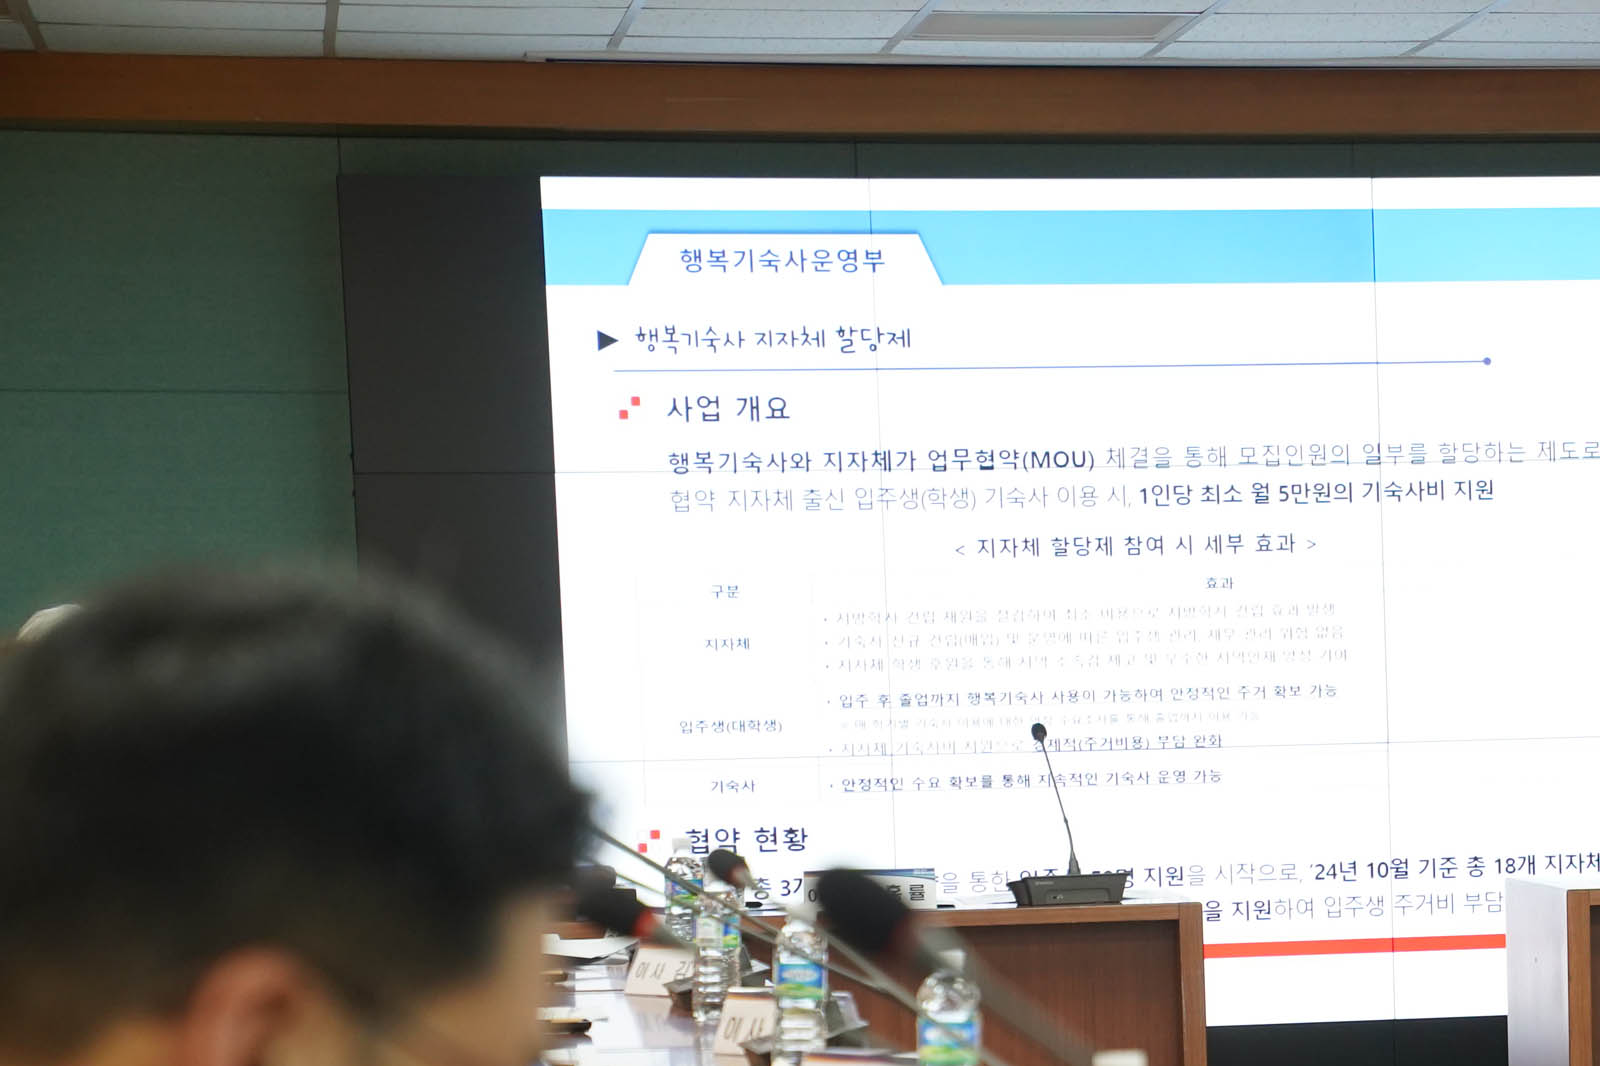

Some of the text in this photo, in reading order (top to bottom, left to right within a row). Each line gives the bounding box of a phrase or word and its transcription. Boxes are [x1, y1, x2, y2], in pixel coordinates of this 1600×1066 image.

[680, 249, 886, 273] 행복기숙사운영부
[635, 326, 912, 354] 행복기숙사 지자체 할당제
[667, 396, 790, 423] 사업 개요
[668, 450, 811, 475] 행복기숙사와
[824, 449, 917, 473] 지자체가
[927, 447, 1095, 472] 업무협약(MOU)
[1106, 446, 1172, 469] 체결을
[1184, 445, 1228, 468] 통해
[1238, 443, 1352, 467] 모집인원의
[1362, 442, 1427, 466] 일부를
[1439, 441, 1526, 464] 할당하는
[671, 489, 716, 513] 협약
[728, 488, 794, 512] 지자체
[803, 488, 844, 512] 출신
[854, 486, 976, 511] 입주생(학생)
[985, 485, 1048, 509] 기숙사
[1057, 484, 1100, 508] 이용
[1140, 482, 1193, 507] 1인당
[1200, 482, 1243, 506] 최소
[1250, 481, 1270, 505] 월
[1278, 480, 1354, 504] 5만원의
[1361, 480, 1446, 503] 기숙사비
[1454, 479, 1495, 502] 지원
[976, 537, 1041, 558] 지자체
[1050, 536, 1114, 558] 할당제
[1123, 535, 1165, 557] 참여
[1175, 535, 1194, 556] 시
[1204, 534, 1245, 555] 세부
[1254, 533, 1296, 554] 효과
[711, 584, 741, 599] 구분
[1205, 576, 1235, 591] 효과
[704, 636, 751, 652] 지자체
[839, 683, 1338, 709] 입주 후 졸업까지 행복기숙사 사용이 가능하여 안정적인 주거 확보 가능
[679, 719, 783, 736] 입주생(대학생)
[1157, 733, 1186, 750] 부담
[1193, 732, 1223, 750] 완화
[711, 778, 756, 794] 기숙사
[841, 776, 905, 793] 안정적인
[912, 776, 942, 790] 수요
[949, 774, 993, 790] 확보를
[1002, 773, 1032, 789] 통해
[1105, 769, 1150, 786] 기숙사
[1157, 768, 1187, 785] 운영
[1193, 768, 1223, 784] 가능
[685, 826, 809, 855] 협약 현황
[1143, 864, 1205, 888] 지원을
[1214, 862, 1304, 887] 시작으로,
[1365, 857, 1410, 880] 10월
[1417, 855, 1459, 879] 기준
[1466, 854, 1486, 878] 총
[1494, 853, 1537, 876] 18개
[1231, 898, 1315, 921] 지원하여
[1324, 896, 1386, 919] 입주생
[1393, 893, 1456, 917] 주거비
[1463, 891, 1505, 914] 부담
